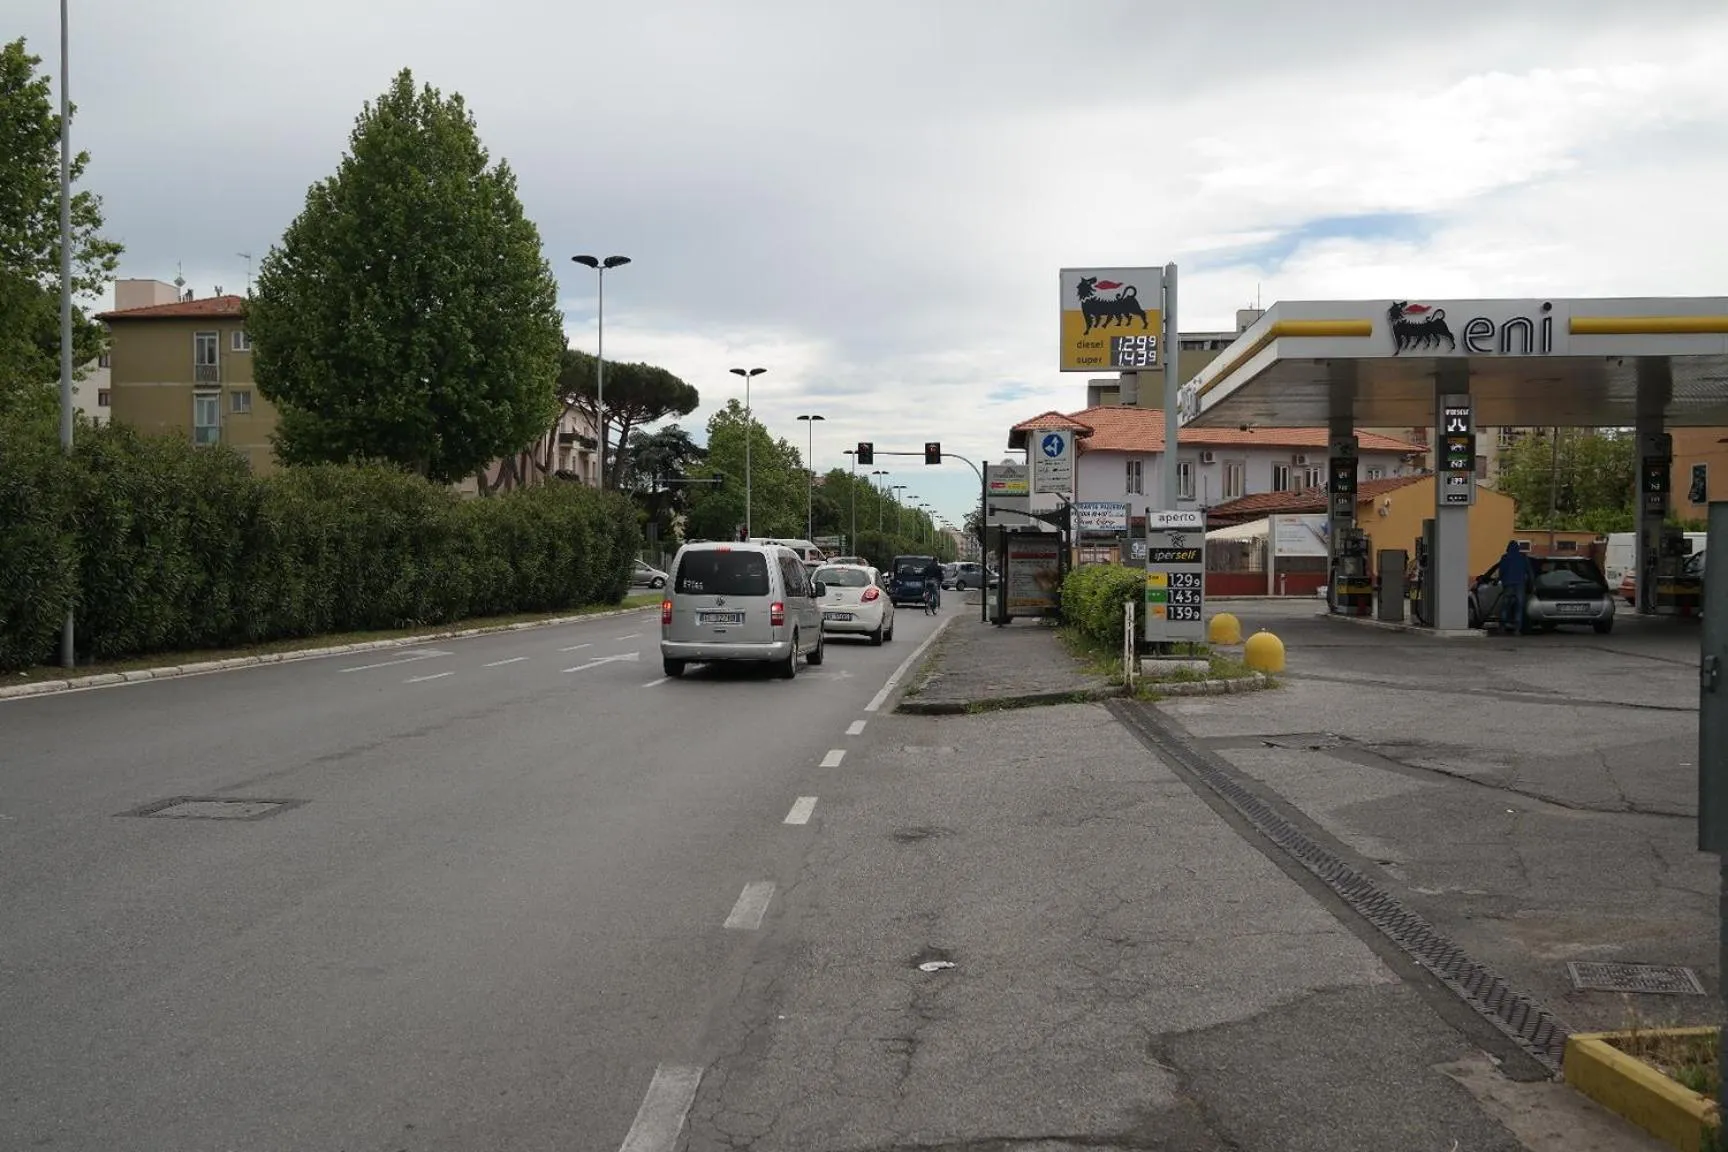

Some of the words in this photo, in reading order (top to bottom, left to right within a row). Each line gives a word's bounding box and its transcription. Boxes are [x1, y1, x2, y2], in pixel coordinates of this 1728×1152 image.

[1464, 302, 1552, 353] eni
[1076, 340, 1103, 349] diesel
[1076, 356, 1102, 365] super
[1158, 514, 1196, 524] aperto
[1154, 550, 1197, 561] iperself
